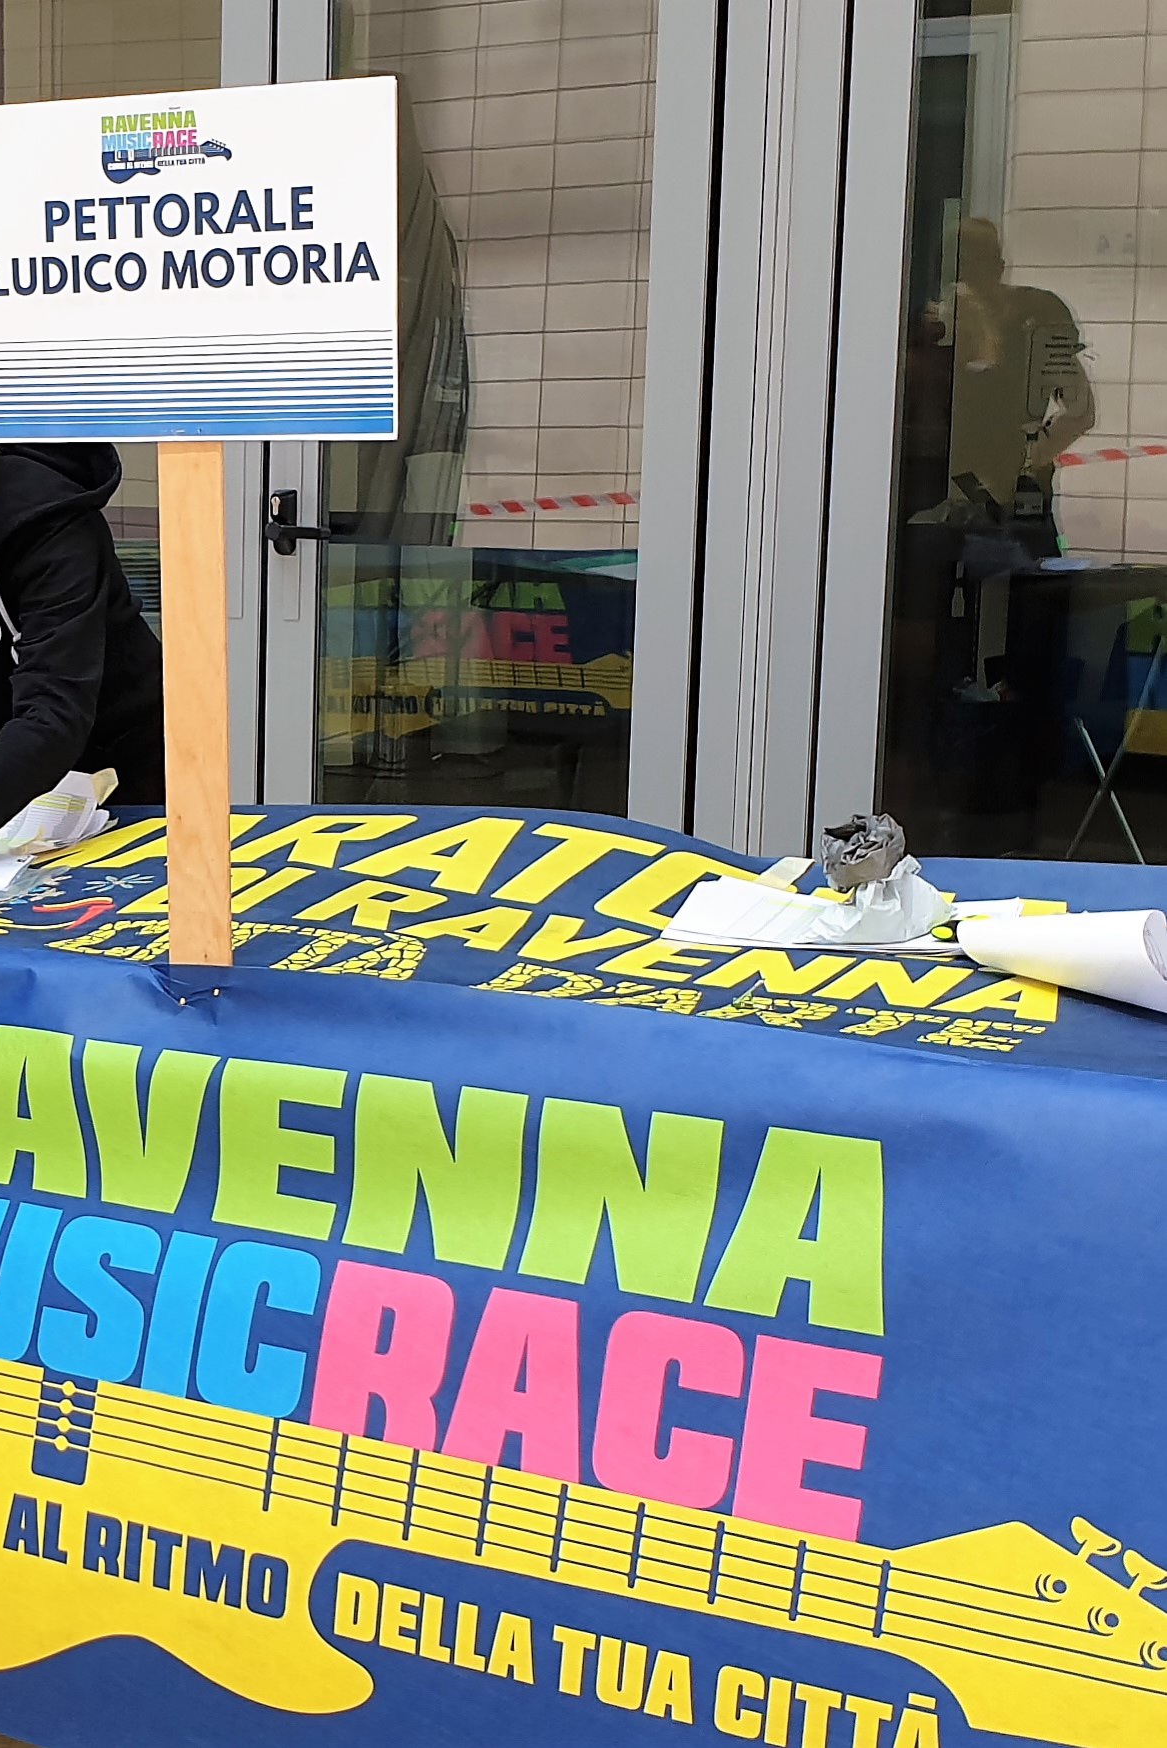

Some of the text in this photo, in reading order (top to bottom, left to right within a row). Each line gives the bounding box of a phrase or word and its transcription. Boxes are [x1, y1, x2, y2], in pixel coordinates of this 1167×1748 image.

[101, 110, 197, 134] RAVENNA
[101, 129, 197, 152] MUSIC RACE
[44, 186, 314, 243] PETTORALE
[161, 241, 380, 289] MOTORIA
[293, 880, 1059, 1023] RAVENNA
[308, 1258, 884, 1543] RACE
[2, 1493, 68, 1565] AL
[82, 1510, 290, 1620] RITMO
[332, 1571, 536, 1686] DELLA
[552, 1624, 695, 1728] TUA
